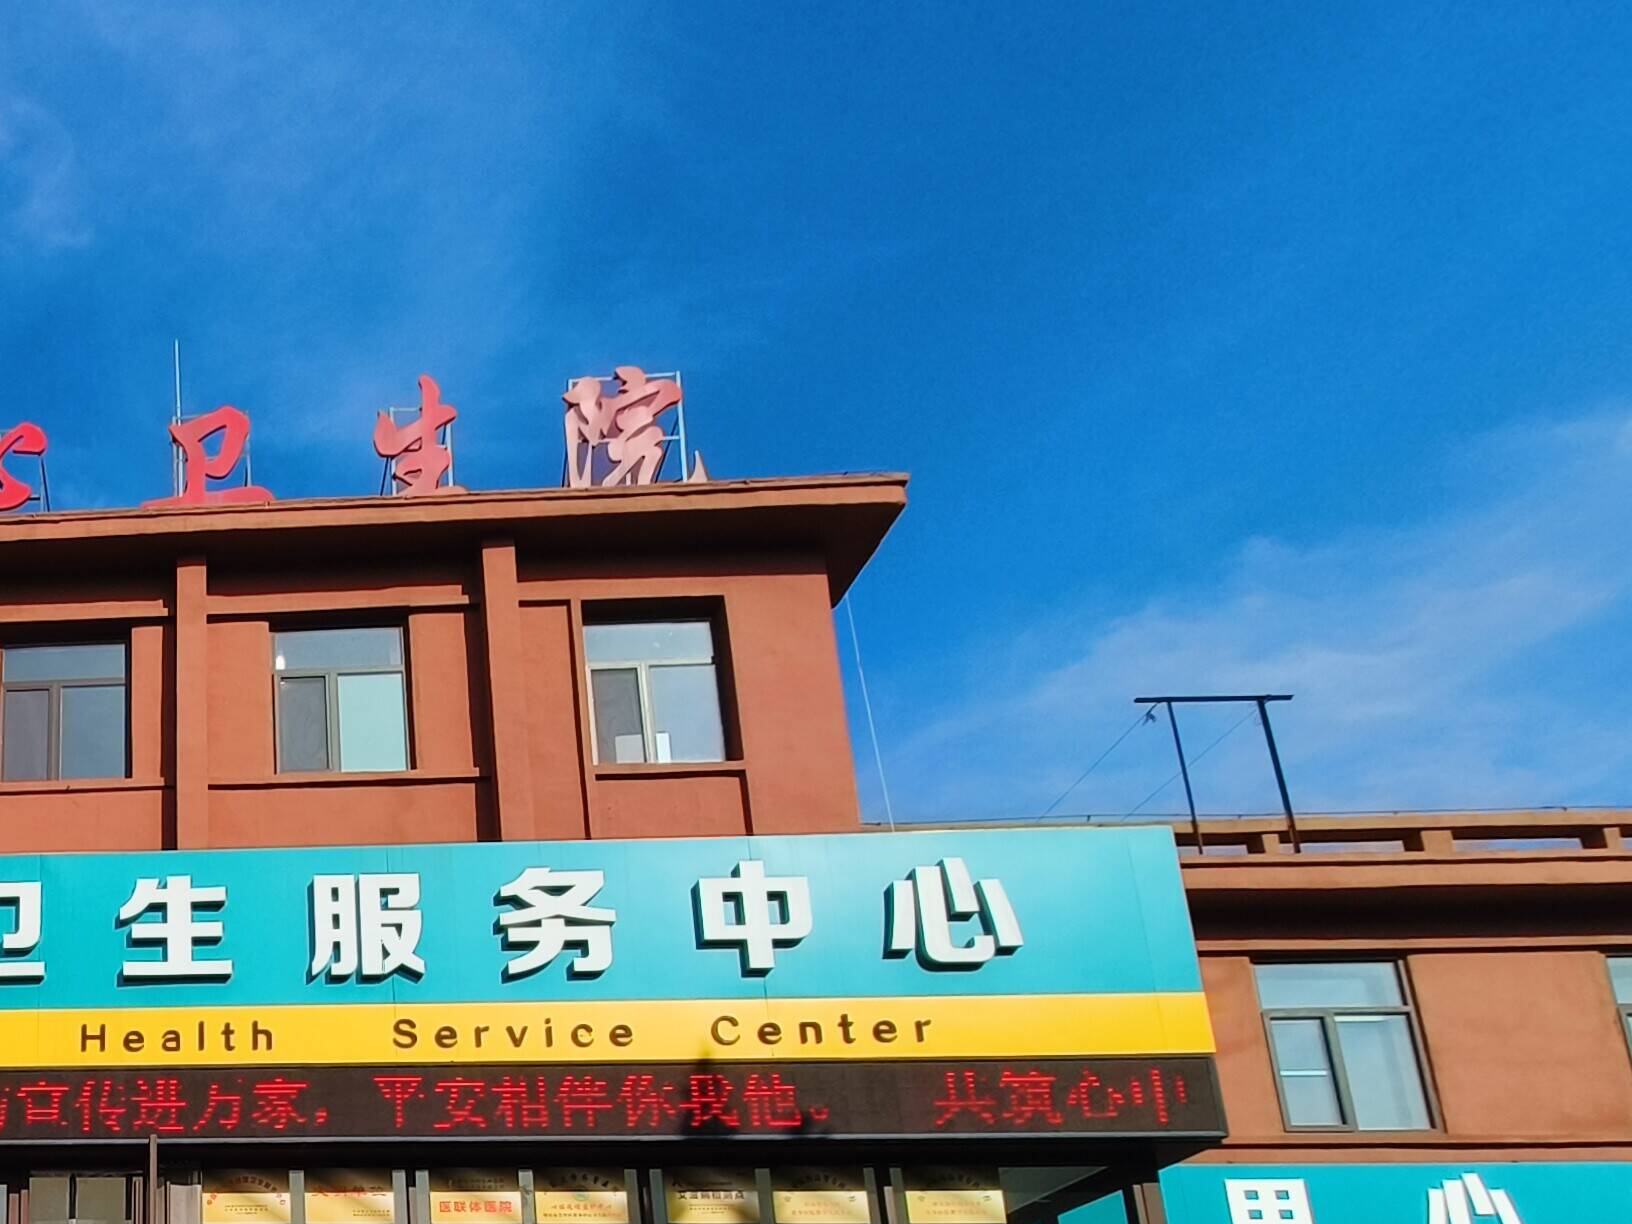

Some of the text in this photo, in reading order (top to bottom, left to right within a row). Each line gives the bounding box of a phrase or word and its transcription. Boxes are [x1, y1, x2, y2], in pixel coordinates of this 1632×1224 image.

[80, 1021, 274, 1053] Health
[392, 1018, 634, 1049] Service
[710, 1014, 933, 1046] Center
[439, 1200, 513, 1213] 医联体医院
